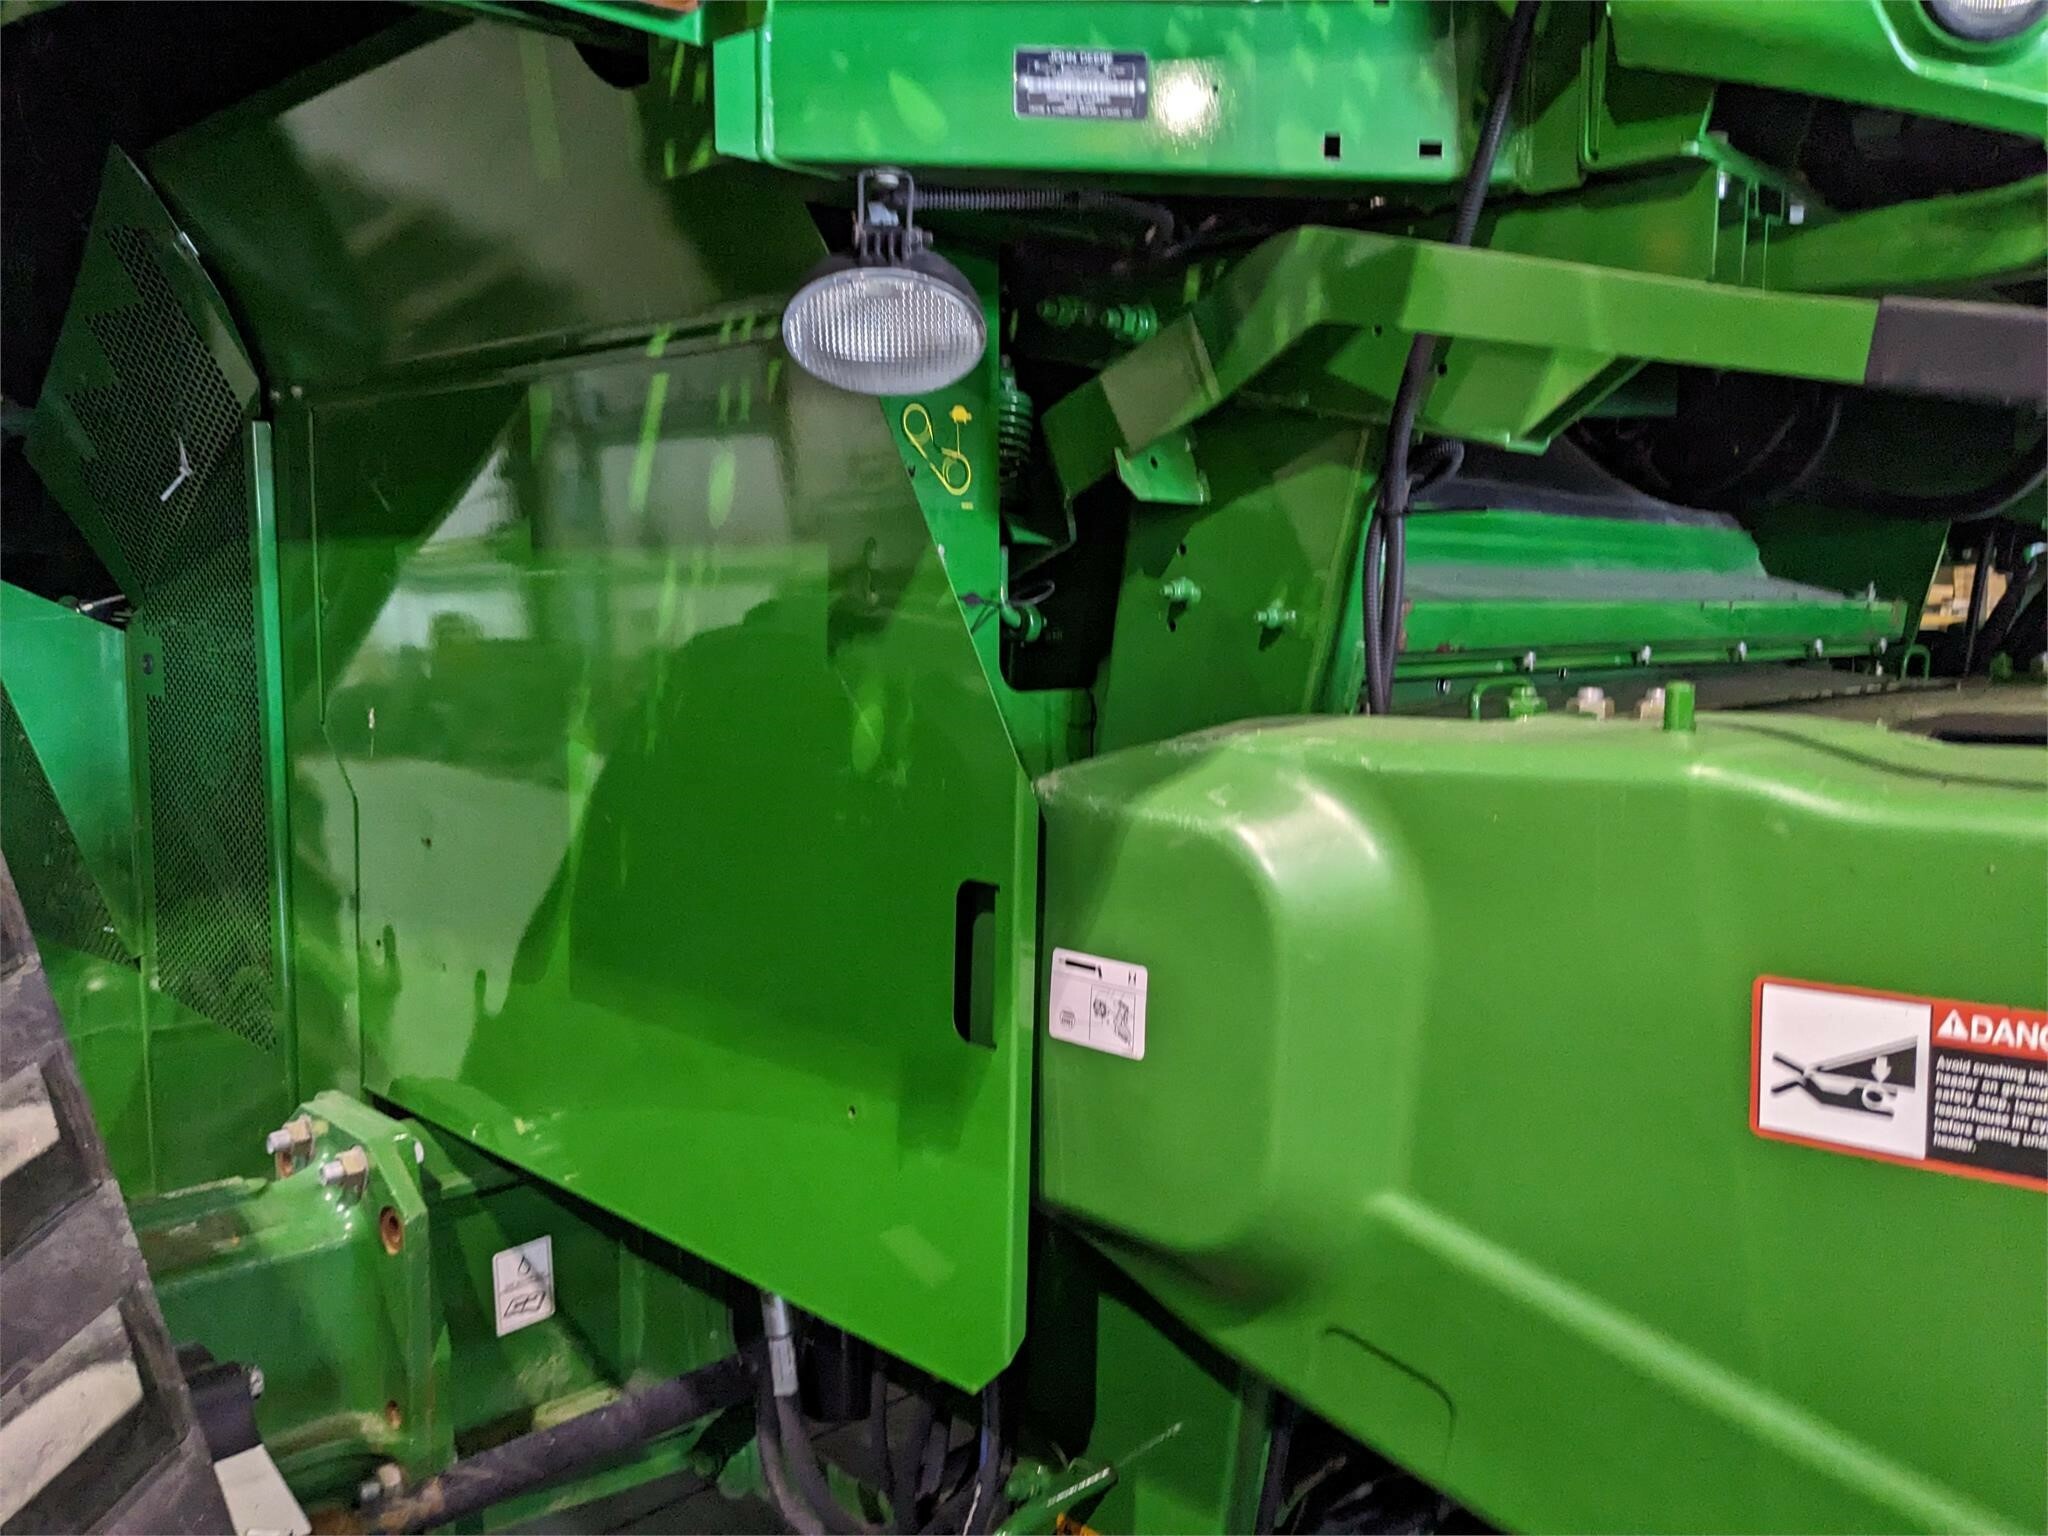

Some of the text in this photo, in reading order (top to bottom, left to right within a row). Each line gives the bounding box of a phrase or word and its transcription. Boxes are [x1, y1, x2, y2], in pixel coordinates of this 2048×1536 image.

[1048, 50, 1113, 66] JOHN DEERE
[1935, 1071, 1979, 1091] header
[1981, 1079, 1999, 1095] on
[1936, 1054, 1971, 1074] Avoid
[1973, 1061, 2026, 1085] crushing
[1934, 1087, 1975, 1107] safety
[1934, 1101, 2010, 1128] feederhouse
[2012, 1113, 2030, 1131] lift
[1933, 1116, 1974, 1137] before
[1975, 1124, 2020, 1147] getting
